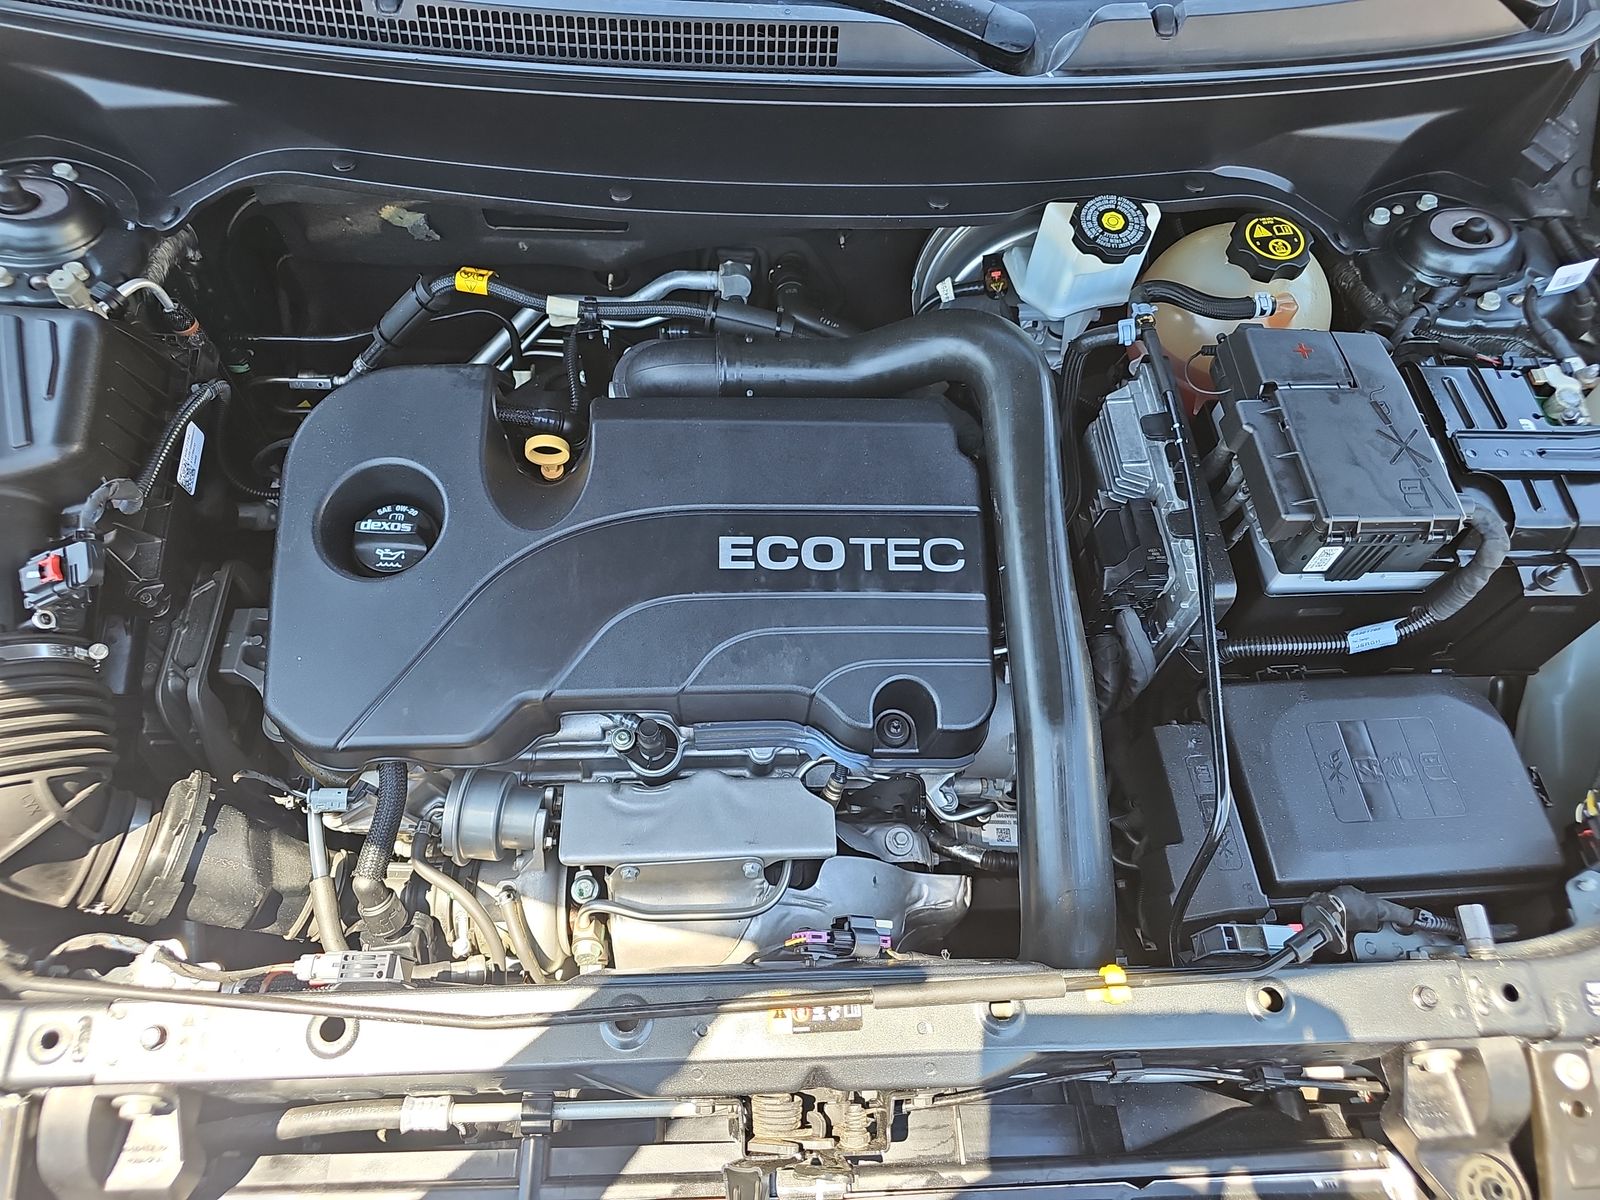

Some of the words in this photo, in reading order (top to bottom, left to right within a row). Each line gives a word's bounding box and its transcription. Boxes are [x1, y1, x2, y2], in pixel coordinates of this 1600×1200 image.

[377, 505, 392, 515] SAE
[395, 505, 419, 516] 0W-20
[360, 519, 413, 532] dexos
[718, 535, 966, 573] ECOTEC
